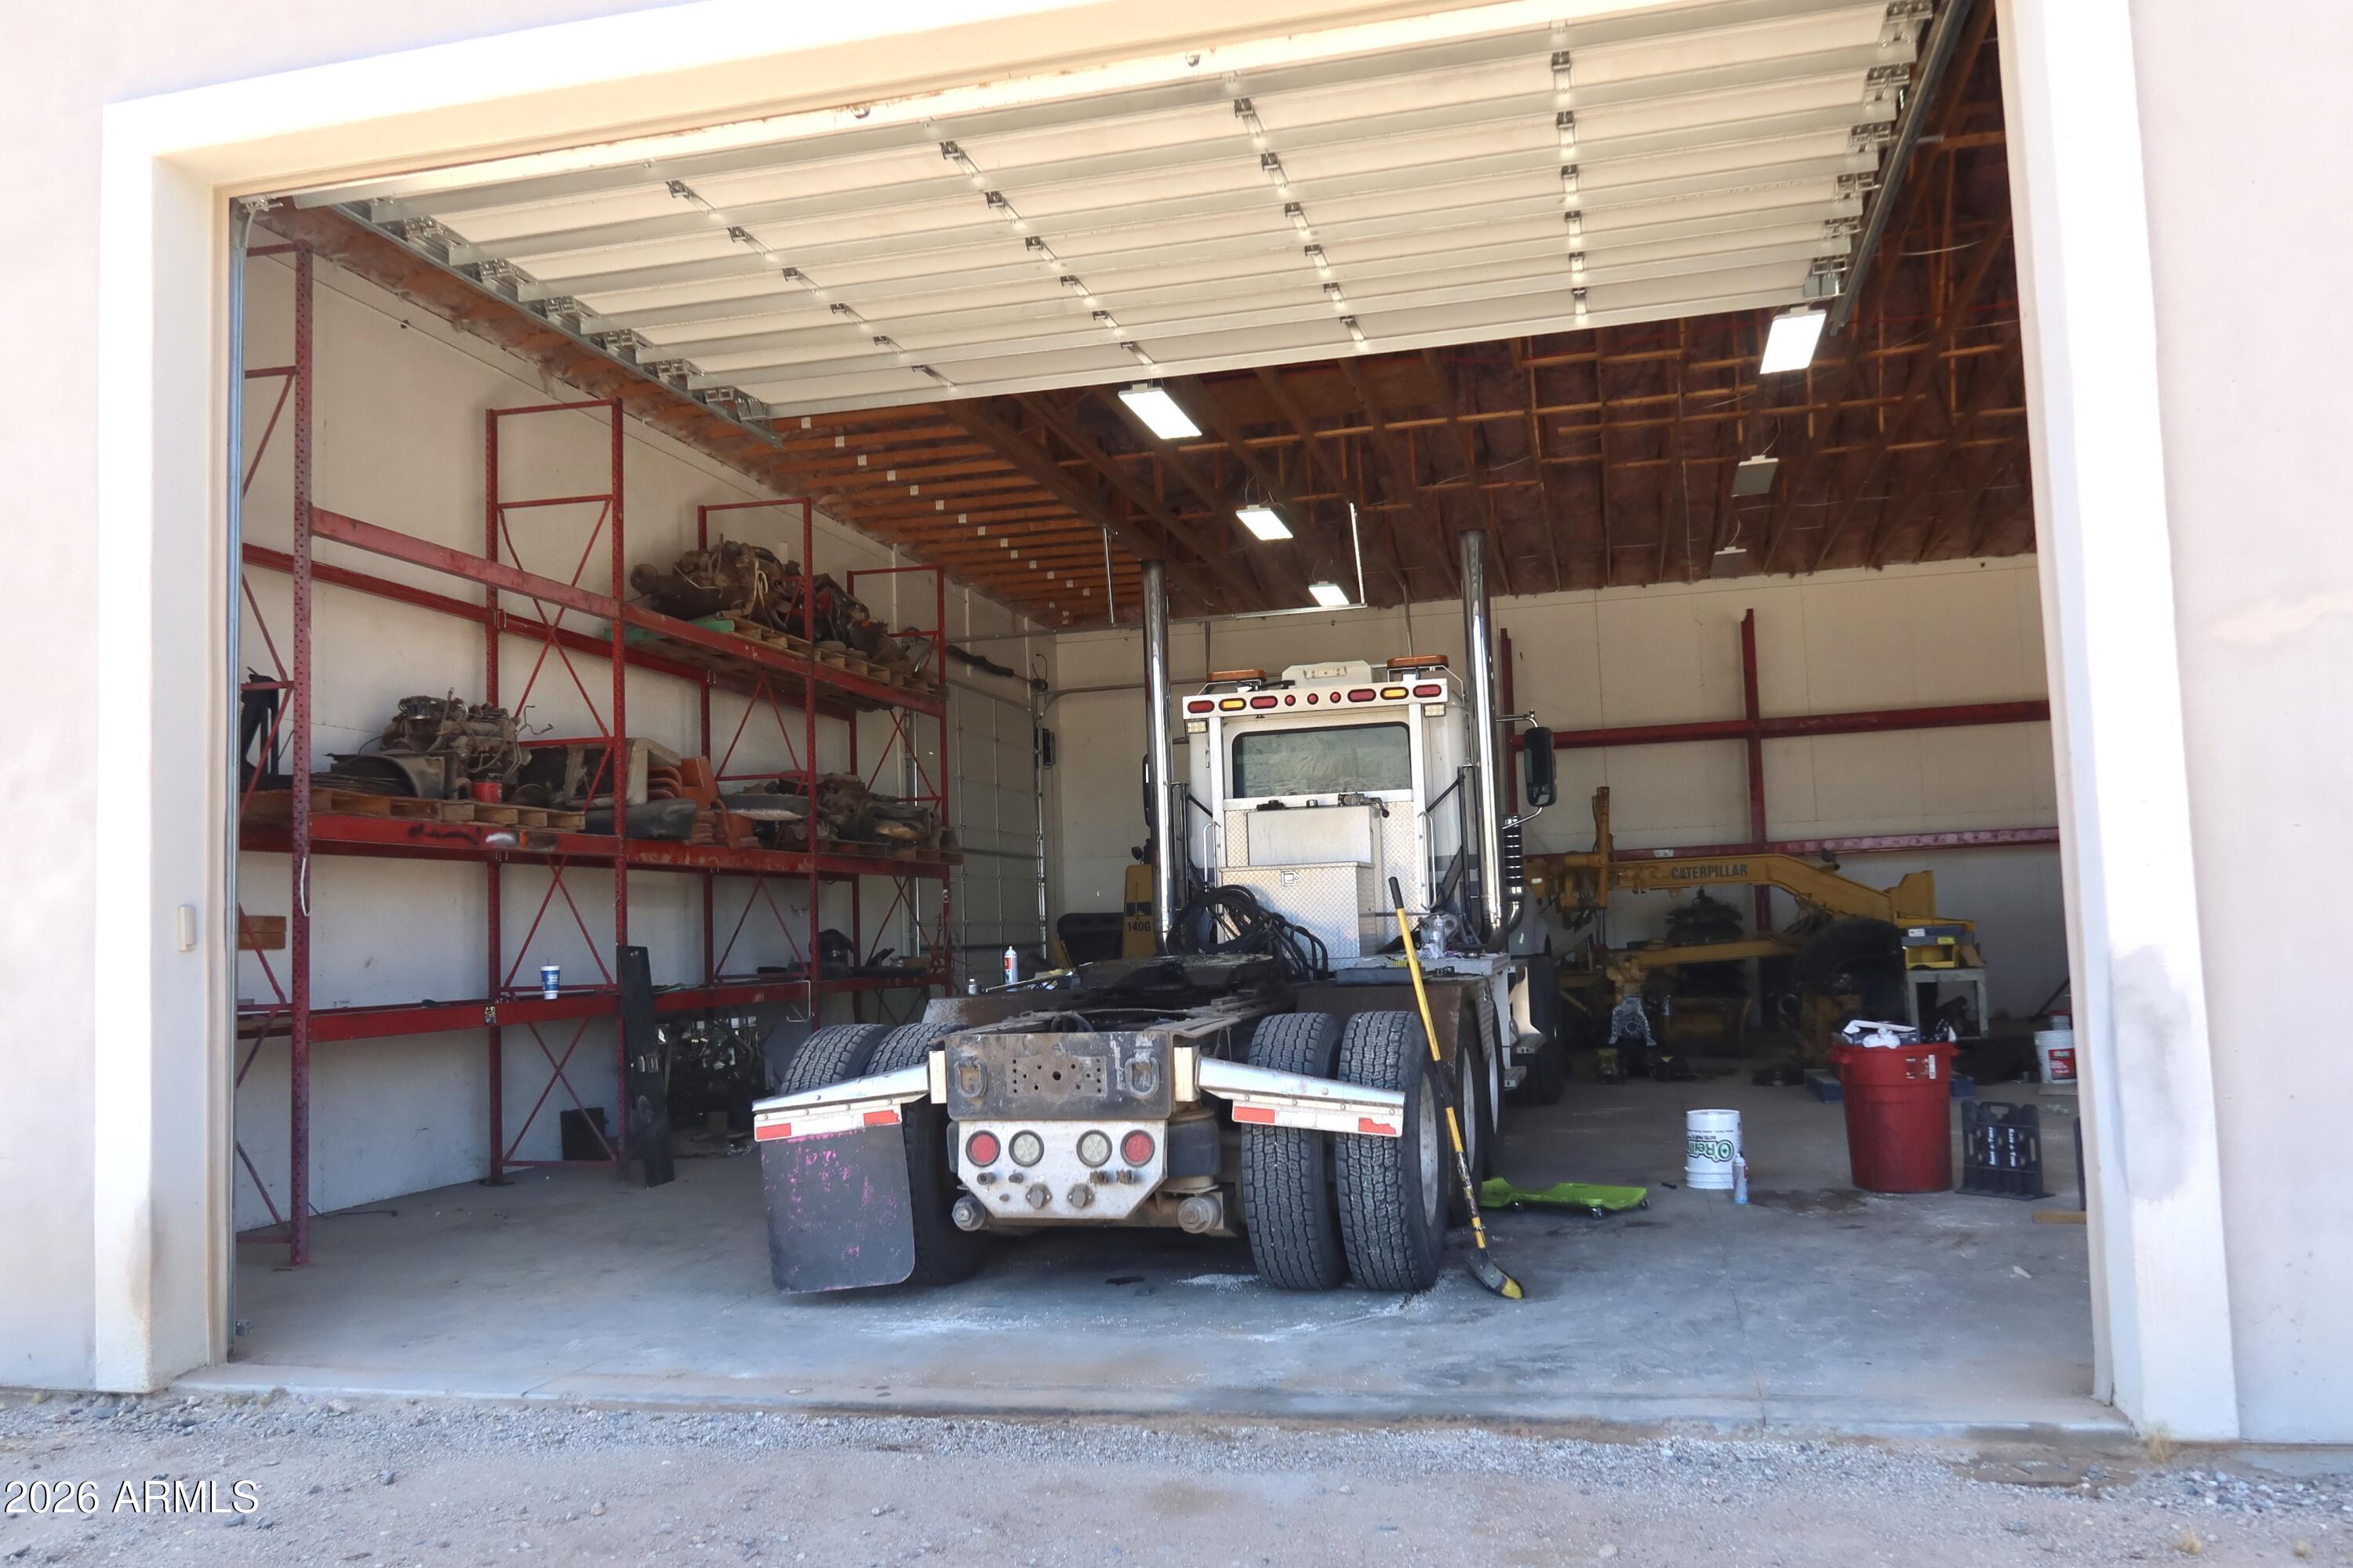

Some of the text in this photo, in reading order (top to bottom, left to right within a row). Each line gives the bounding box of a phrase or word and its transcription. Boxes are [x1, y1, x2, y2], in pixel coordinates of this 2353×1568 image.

[1671, 864, 1747, 879] CATERPILLAR
[1128, 921, 1151, 932] 140G
[1688, 1141, 1733, 1162] O'Reill
